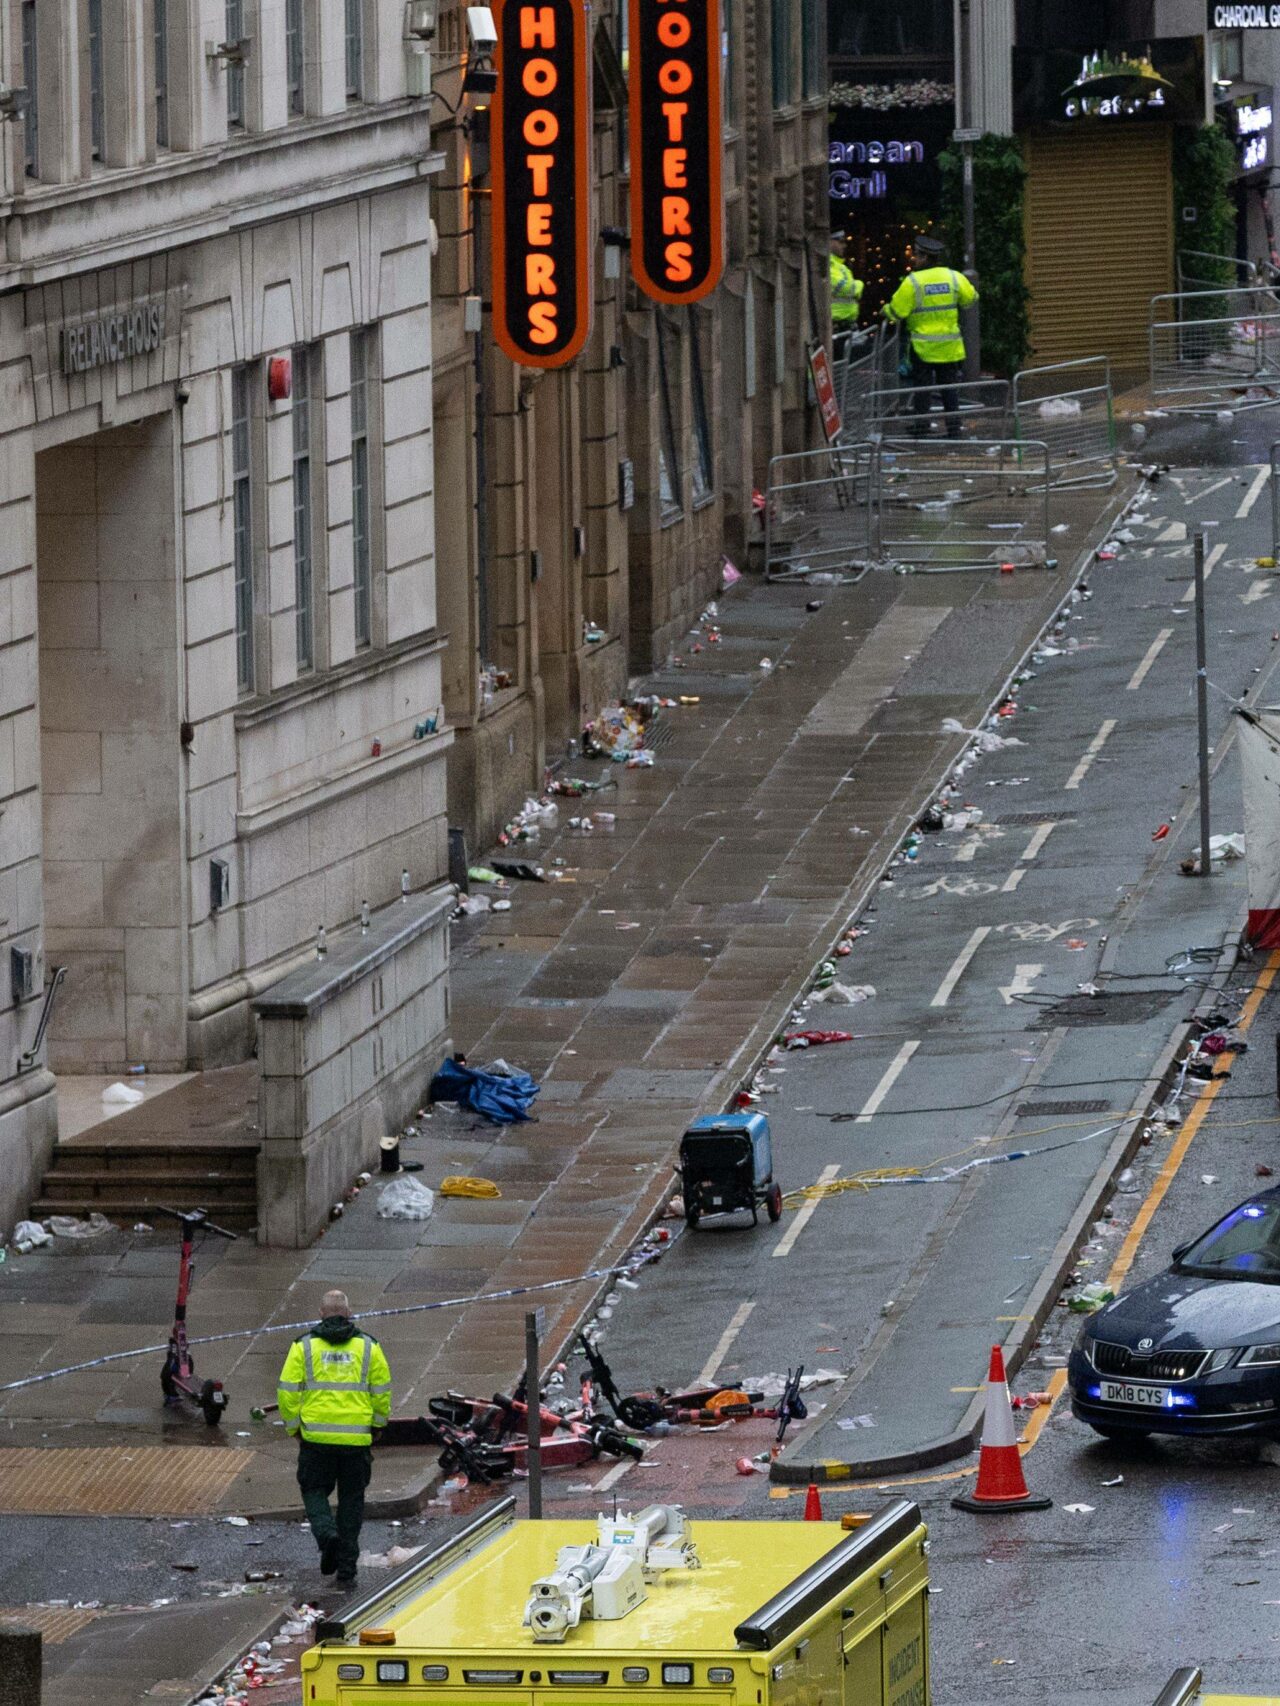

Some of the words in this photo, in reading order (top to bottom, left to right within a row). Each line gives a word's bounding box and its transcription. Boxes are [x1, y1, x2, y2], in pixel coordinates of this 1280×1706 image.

[1214, 5, 1269, 28] CHARCOAL
[656, 0, 692, 282] OOTERS
[519, 6, 559, 345] HOOTERS
[828, 170, 887, 199] Grill
[64, 315, 125, 374] RELIANCE
[1107, 1385, 1134, 1401] DK18
[1137, 1388, 1162, 1404] CYS
